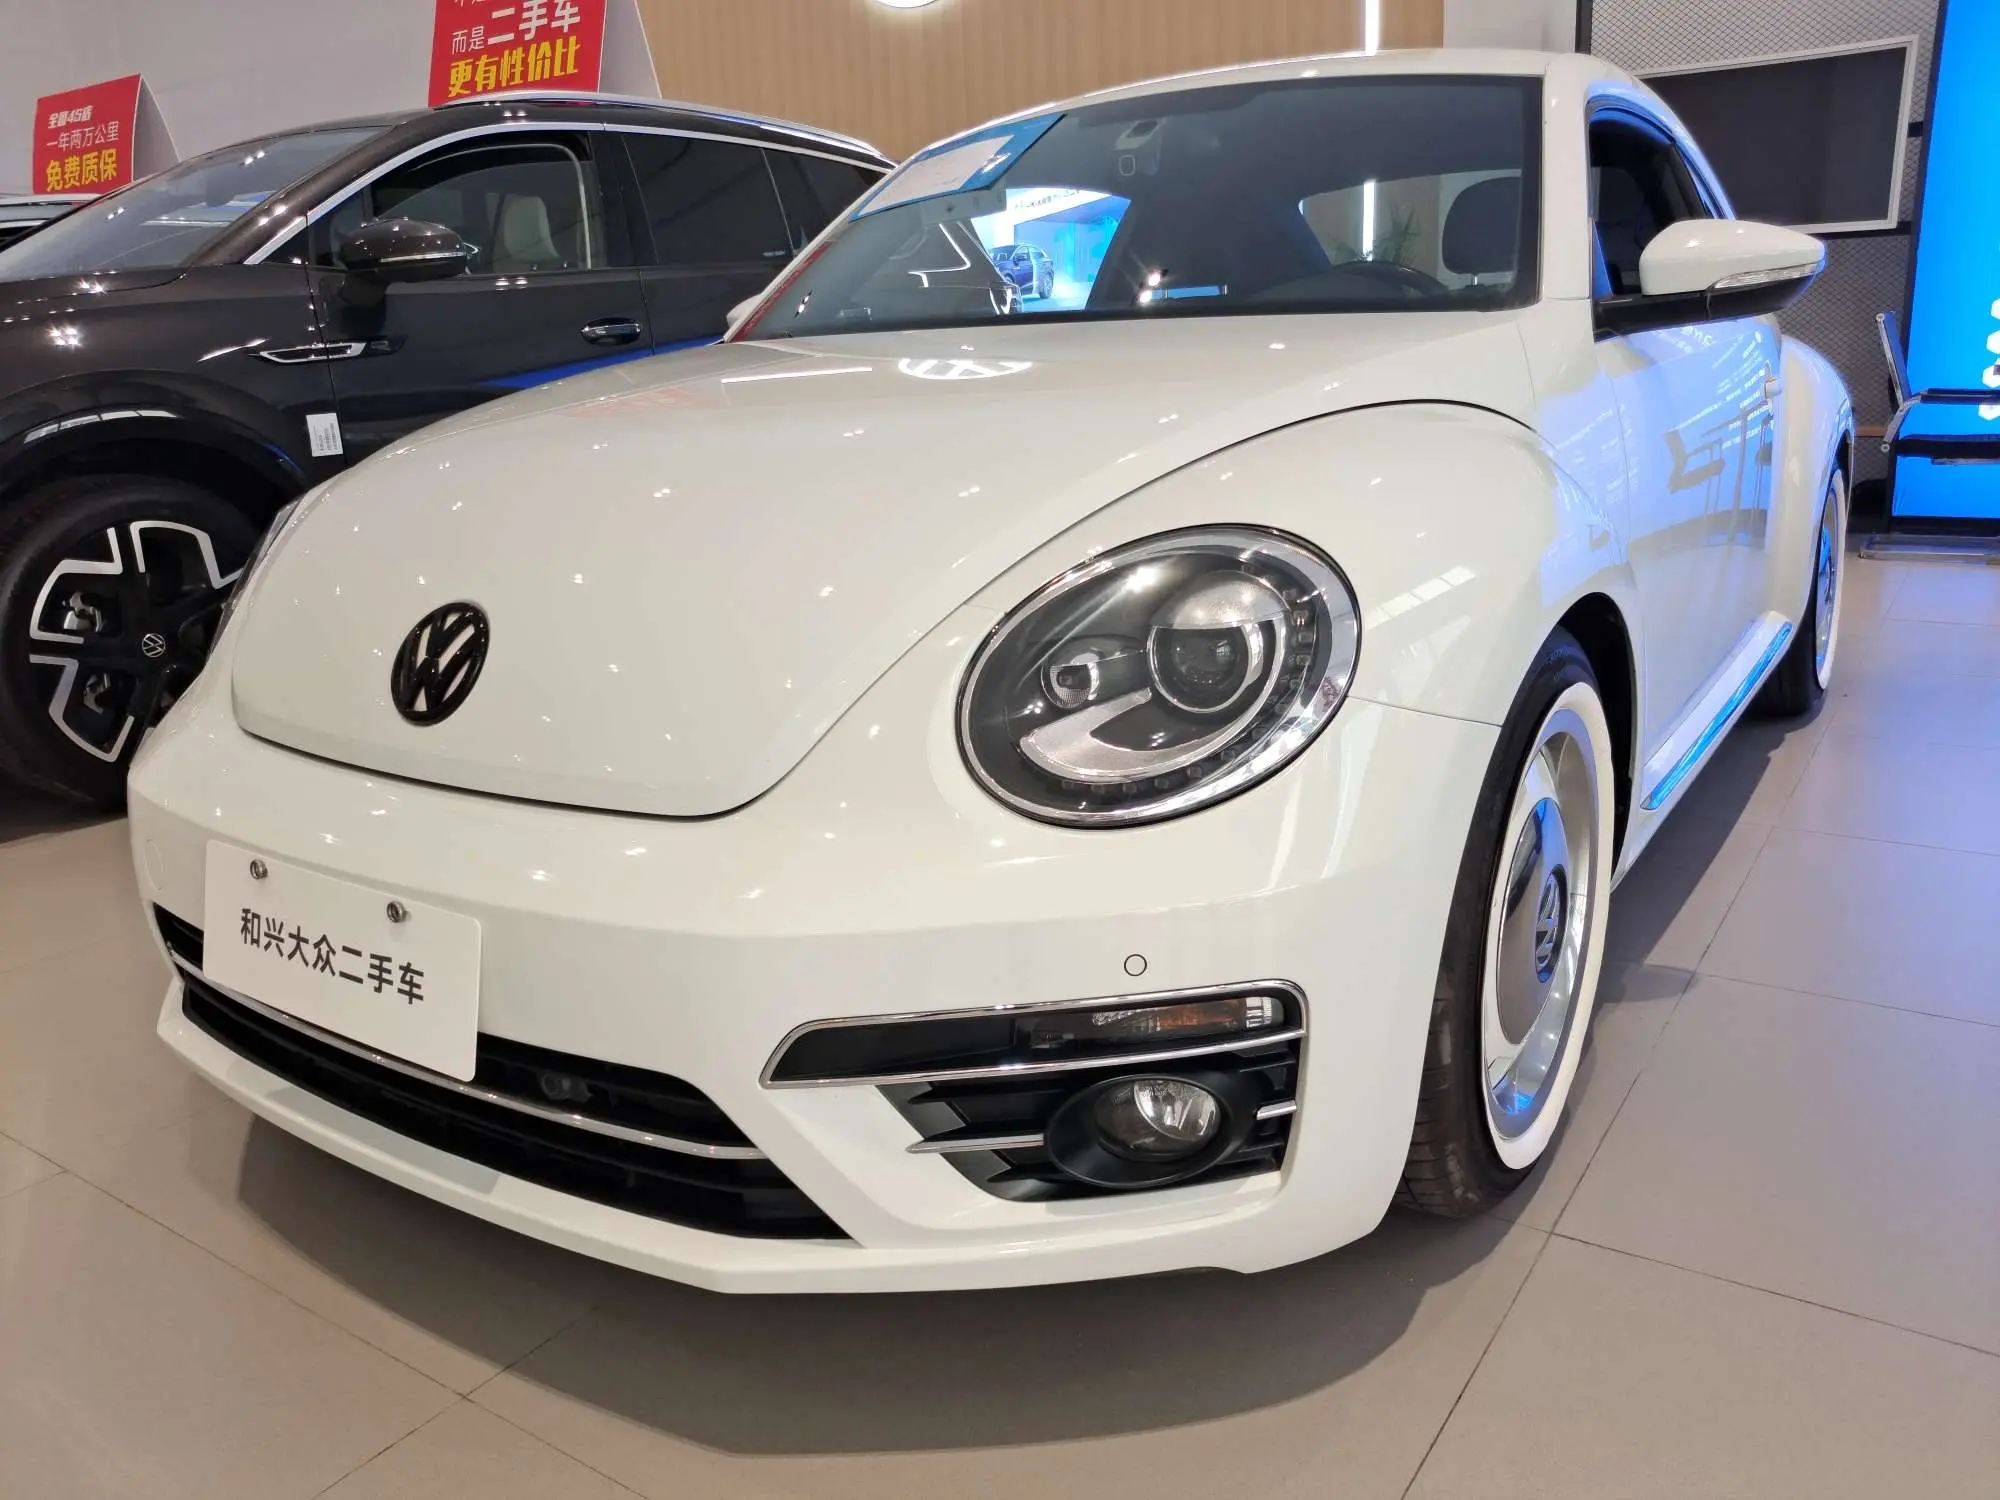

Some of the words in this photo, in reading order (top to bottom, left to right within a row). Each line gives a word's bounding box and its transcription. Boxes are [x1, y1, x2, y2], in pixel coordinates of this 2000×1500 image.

[452, 0, 581, 55] 而是二手车
[448, 36, 581, 97] 更有性价比
[46, 121, 119, 152] 一年两万公里
[46, 148, 117, 193] 免费质保
[240, 908, 424, 1005] 和兴大众二手车
